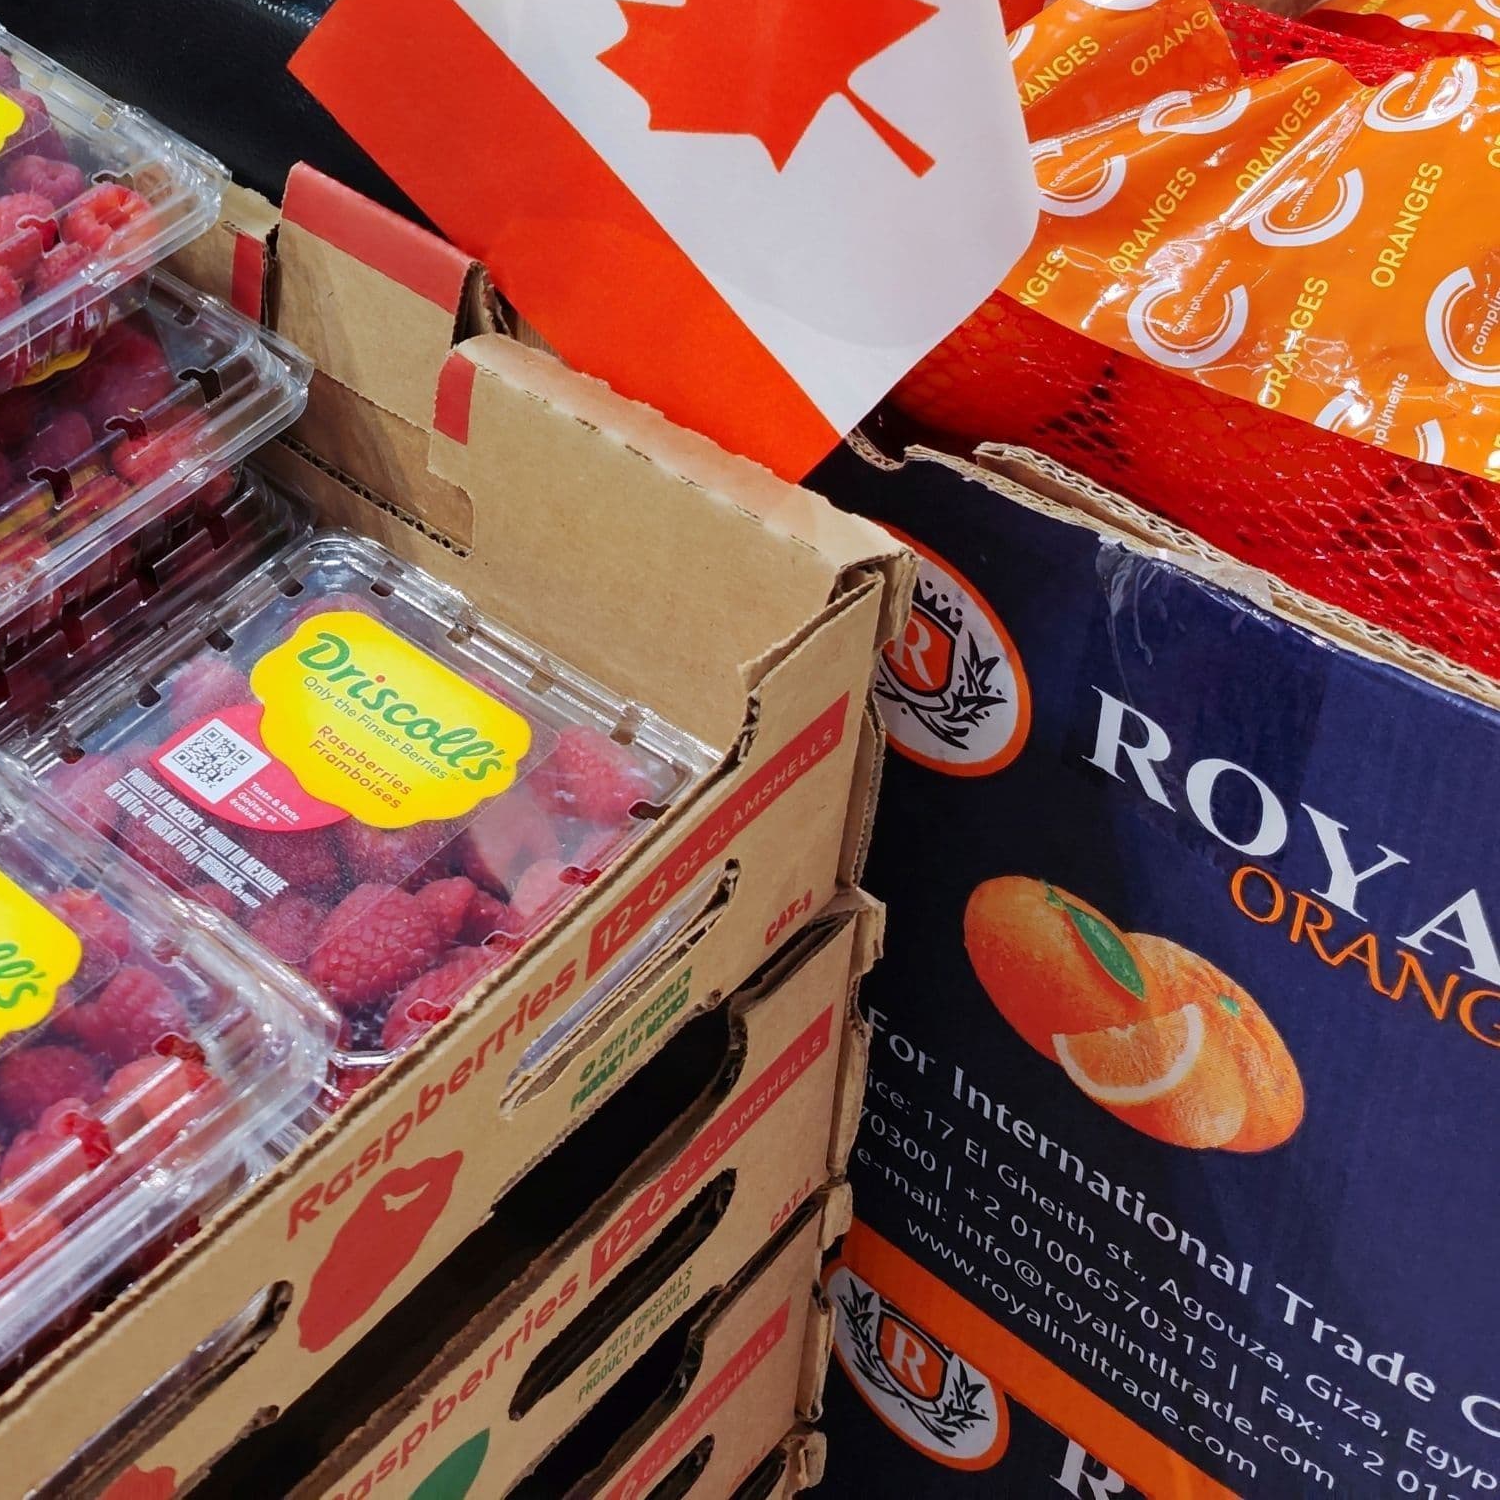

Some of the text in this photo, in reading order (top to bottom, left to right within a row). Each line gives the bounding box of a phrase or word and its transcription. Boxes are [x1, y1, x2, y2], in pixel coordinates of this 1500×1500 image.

[1020, 35, 1100, 107] ANGES
[1130, 10, 1210, 76] ORANG
[1234, 84, 1322, 193] ORANGES
[1019, 247, 1070, 309] NGES
[1107, 165, 1197, 276] ORANGES
[1370, 160, 1444, 289] ORANGES
[1169, 257, 1232, 336] compliments
[1256, 275, 1330, 409] ORANGES
[1371, 371, 1410, 448] mpliments
[298, 632, 506, 781] Driscoll's
[303, 675, 449, 780] Only the Finest Berries
[317, 725, 413, 796] Raspberries
[124, 767, 165, 798] PRODUCT
[163, 798, 205, 830] MEXICO
[199, 826, 240, 856] PRODUIT
[239, 857, 290, 896] MEXIQUE
[251, 781, 300, 822] Taste & Rate
[266, 814, 277, 824] et
[309, 740, 402, 809] Framboises
[1081, 684, 1500, 987] ROYA
[286, 958, 578, 1243] Raspberries
[599, 874, 668, 952] 12-6
[706, 728, 833, 851] CLAMSHELLS
[1229, 865, 1500, 1048] ORANG
[570, 987, 690, 1113] PRODUCT OF MEXICO
[328, 1271, 580, 1500] aspberries
[599, 1184, 666, 1263] 12-6
[703, 1035, 821, 1162] CLAMSHELLS
[867, 1004, 1500, 1438] For International Trade C
[867, 1069, 913, 1115] ice:
[924, 1109, 954, 1140] 17
[964, 1138, 987, 1168] El
[997, 1163, 1095, 1244] Gheith
[1159, 1278, 1291, 1379] Agouza,
[1305, 1373, 1390, 1439] Giza,
[1404, 1427, 1498, 1491] Egyp
[577, 1284, 691, 1404] PRODUCT OF MEXICO
[634, 1265, 693, 1331] DRISCOLL'S
[856, 1147, 1335, 1490] e-mail: info@royalintltrade.com
[886, 1322, 928, 1394] R
[906, 1218, 1258, 1479] www.royalintltrade.com
[964, 1186, 1001, 1221] +2
[1011, 1214, 1217, 1370] 01006570315
[1260, 1384, 1324, 1441] Fax:
[1337, 1441, 1386, 1477] +2
